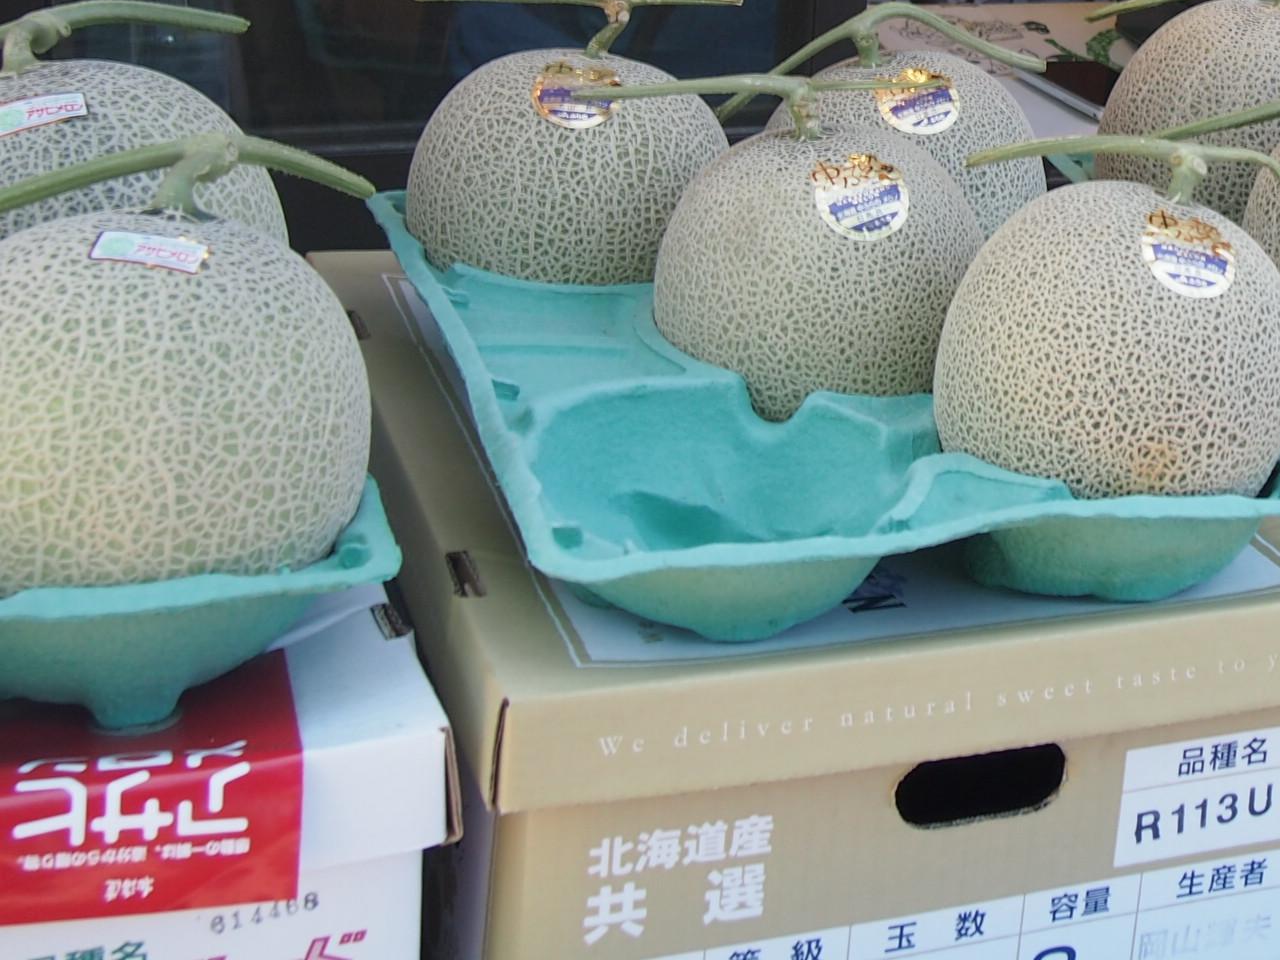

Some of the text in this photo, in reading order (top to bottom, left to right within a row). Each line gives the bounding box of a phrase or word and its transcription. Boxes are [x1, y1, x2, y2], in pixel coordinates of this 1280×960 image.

[26, 102, 83, 121] アサヒメロン
[135, 244, 199, 264] アサヒメロン
[600, 734, 645, 757] We
[674, 716, 814, 748] deliver
[840, 691, 972, 728] natural
[997, 678, 1094, 708] sweet
[1117, 664, 1197, 690] taste
[1218, 657, 1246, 675] to
[1177, 738, 1268, 777] 品種名
[12, 761, 251, 846] アサヒ
[1135, 783, 1273, 844] R113U
[588, 814, 774, 879] 北海道産
[1050, 885, 1112, 922] 容量
[1176, 858, 1268, 900] 生産者
